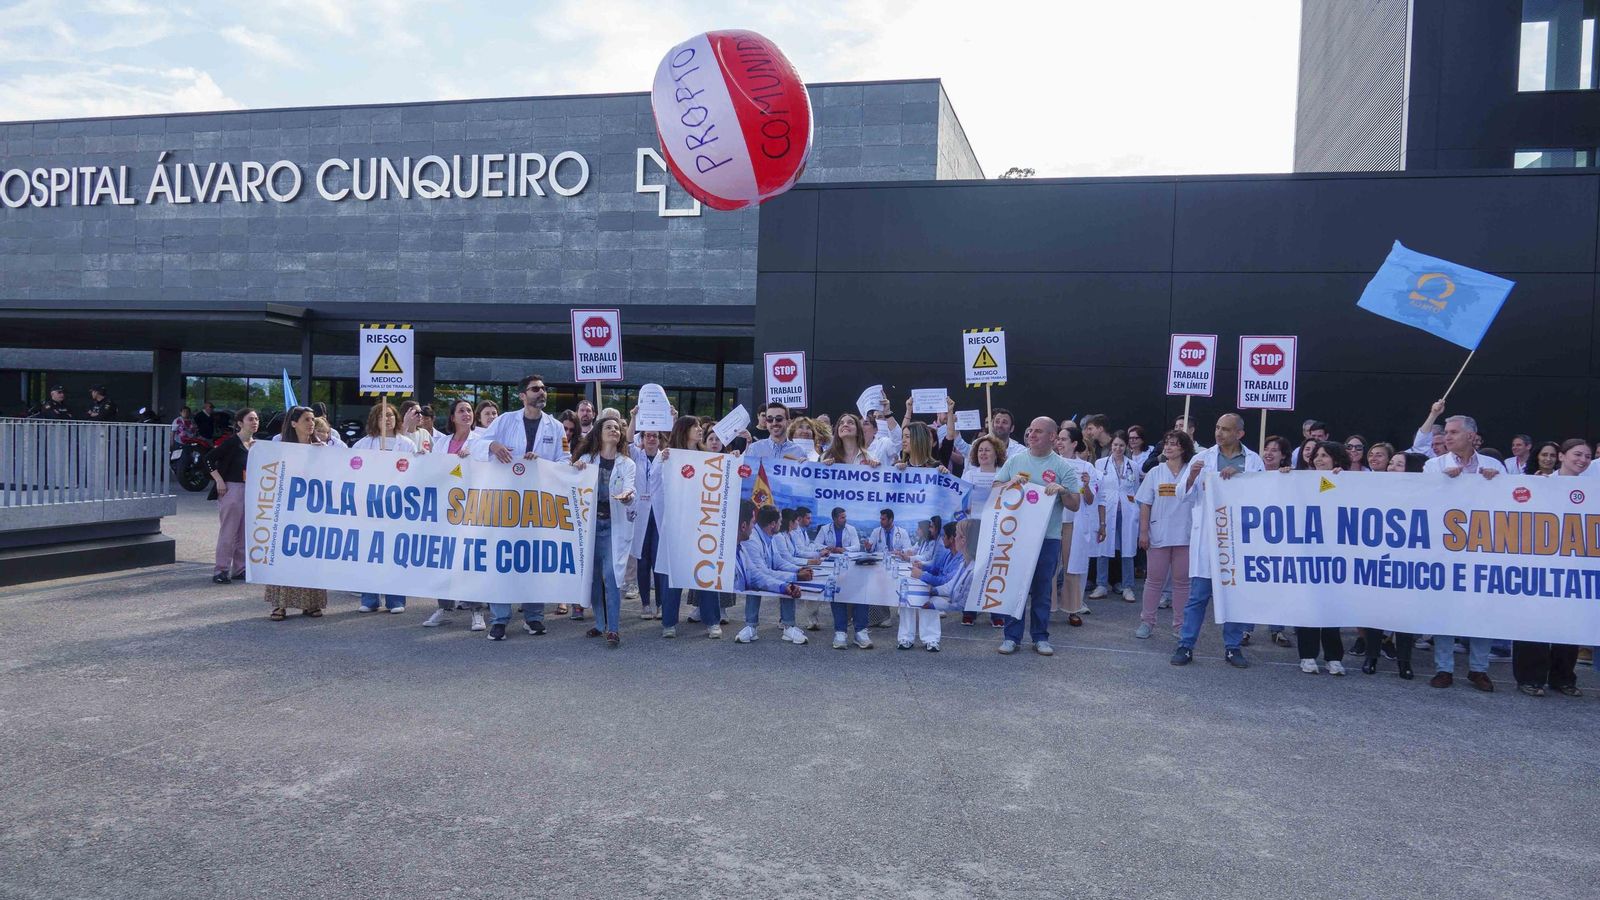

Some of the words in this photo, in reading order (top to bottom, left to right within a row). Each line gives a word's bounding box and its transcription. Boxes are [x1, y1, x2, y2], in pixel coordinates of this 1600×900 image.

[672, 48, 733, 173] PROPIO
[146, 151, 302, 204] ÁLVARO
[316, 150, 589, 201] CUNQUEIRO
[584, 327, 609, 338] STOP
[367, 334, 406, 343] RIESGO
[968, 336, 999, 344] RIESGO
[579, 352, 617, 362] TRABALLO
[1181, 348, 1205, 359] STOP
[1252, 353, 1282, 366] STOP
[581, 366, 593, 374] SEN
[596, 363, 616, 373] LÍMITE
[775, 366, 796, 376] STOP
[1173, 371, 1209, 380] TRABALLO
[770, 386, 802, 394] TRABALLO
[1186, 380, 1207, 390] LÍMITE
[1244, 380, 1288, 390] TRABALLO
[784, 395, 802, 404] LÍMITE
[1245, 393, 1259, 401] SEN
[1262, 391, 1287, 402] LÍMITE
[773, 464, 786, 475] SI
[790, 466, 811, 478] NO
[815, 468, 880, 482] ESTAMOS
[884, 472, 902, 483] EN
[905, 473, 922, 484] LA
[925, 474, 963, 495] MESA,
[815, 488, 864, 501] SOMOS
[867, 491, 883, 502] EL
[886, 489, 926, 504] MENÚ
[287, 477, 357, 516] POLA
[367, 484, 438, 522] NOSA
[447, 487, 574, 531] SANIDADE
[1241, 505, 1324, 544] POLA
[1337, 506, 1430, 549] NOSA
[282, 524, 359, 562] COIDA
[368, 531, 384, 564] A
[394, 532, 456, 568] QUEN
[463, 538, 487, 572] TE
[496, 540, 576, 574] COIDA
[1244, 555, 1346, 584] ESTATUTO
[1354, 553, 1445, 591] MÉDICO
[1453, 563, 1466, 592] E
